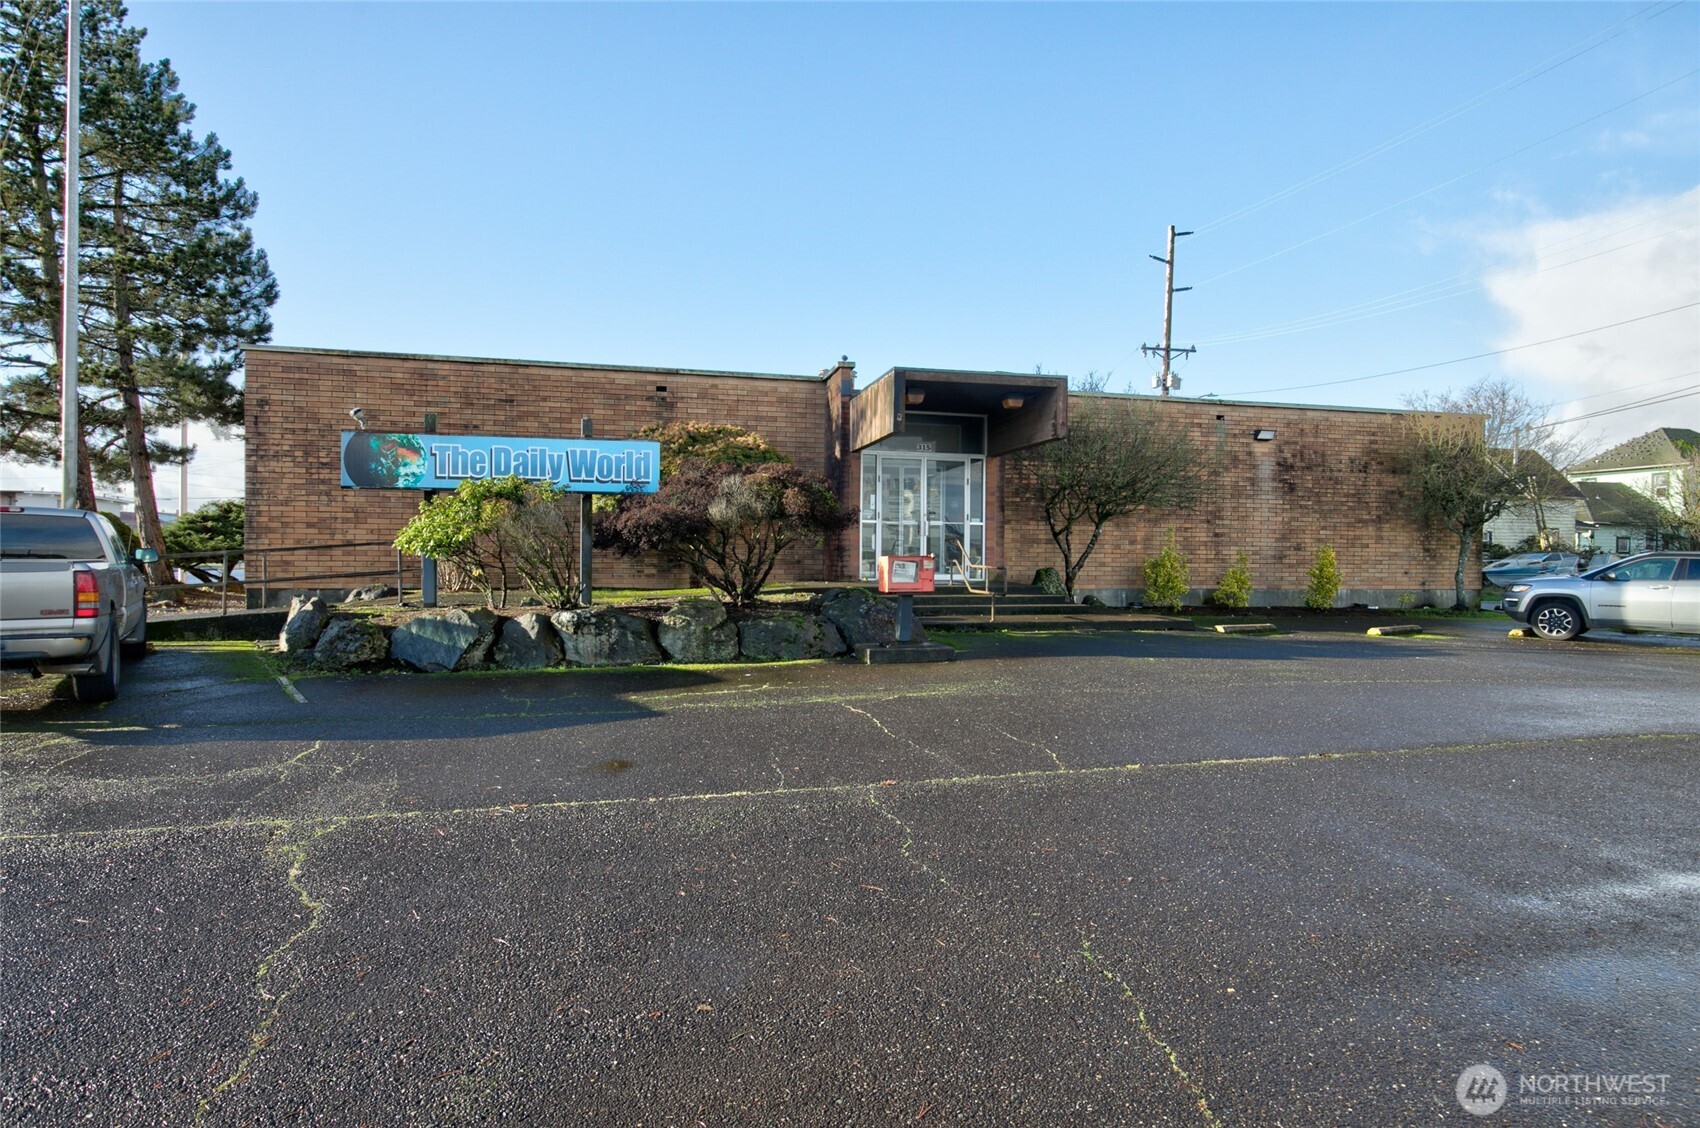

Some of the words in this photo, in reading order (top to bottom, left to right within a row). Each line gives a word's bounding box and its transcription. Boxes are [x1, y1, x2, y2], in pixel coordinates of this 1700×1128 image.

[431, 443, 487, 479] The
[491, 446, 564, 482] Daily
[566, 448, 652, 484] World
